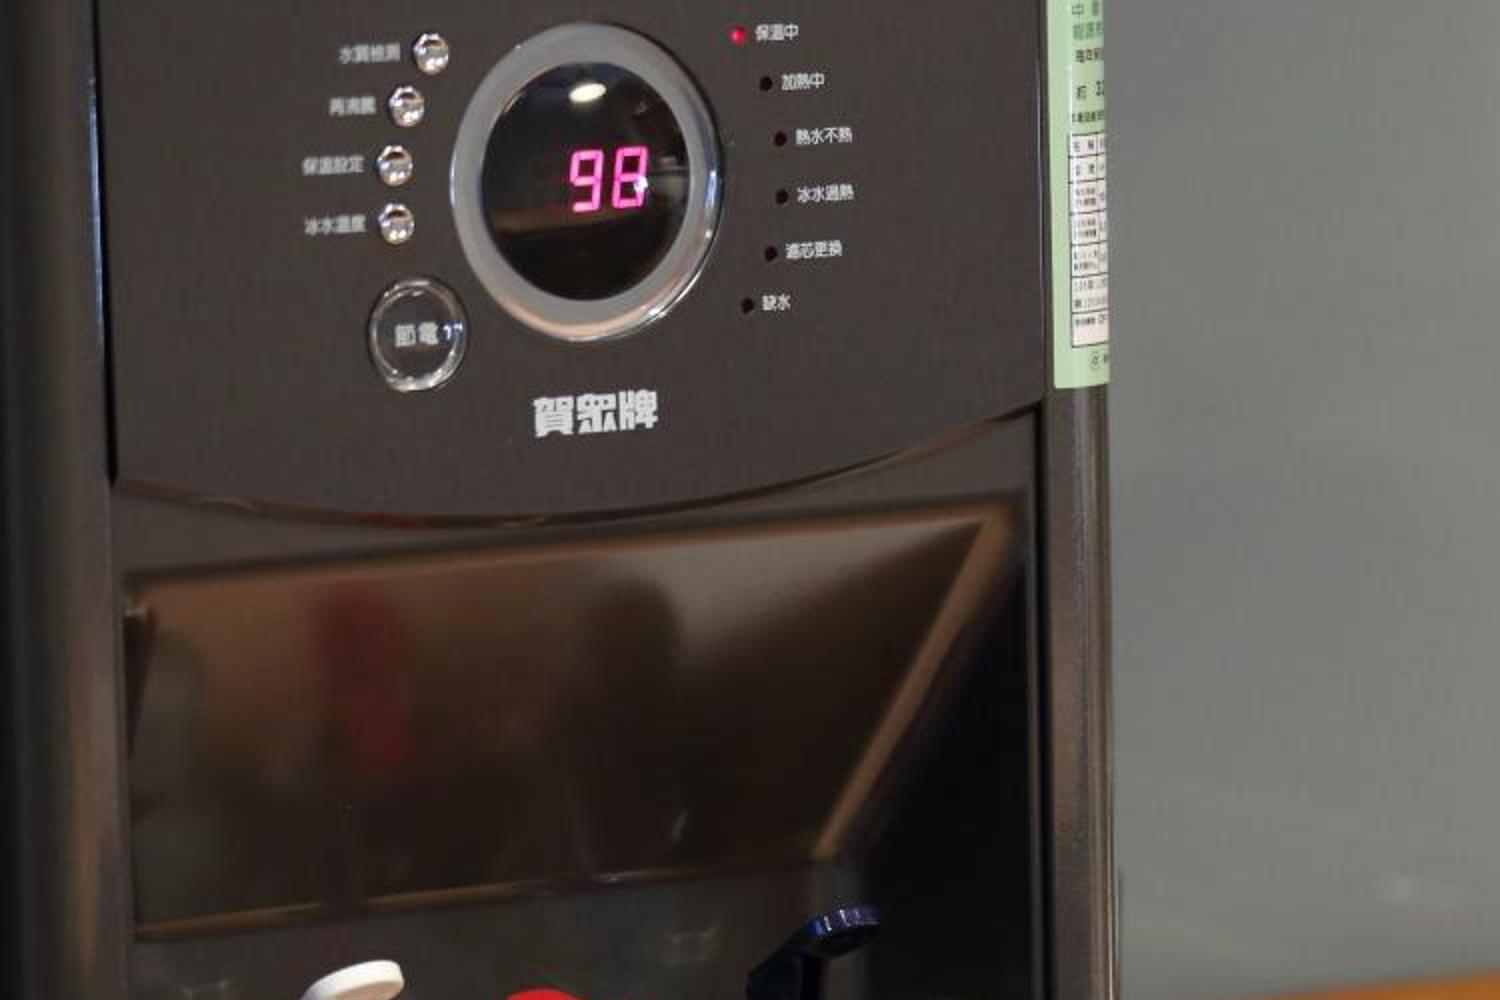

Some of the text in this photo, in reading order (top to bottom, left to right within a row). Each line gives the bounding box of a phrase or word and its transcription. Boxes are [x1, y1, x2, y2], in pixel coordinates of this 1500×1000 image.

[755, 23, 799, 41] 保溫中
[781, 73, 825, 90] 加熱中
[796, 127, 853, 145] 熱水不熱
[570, 145, 648, 212] 98
